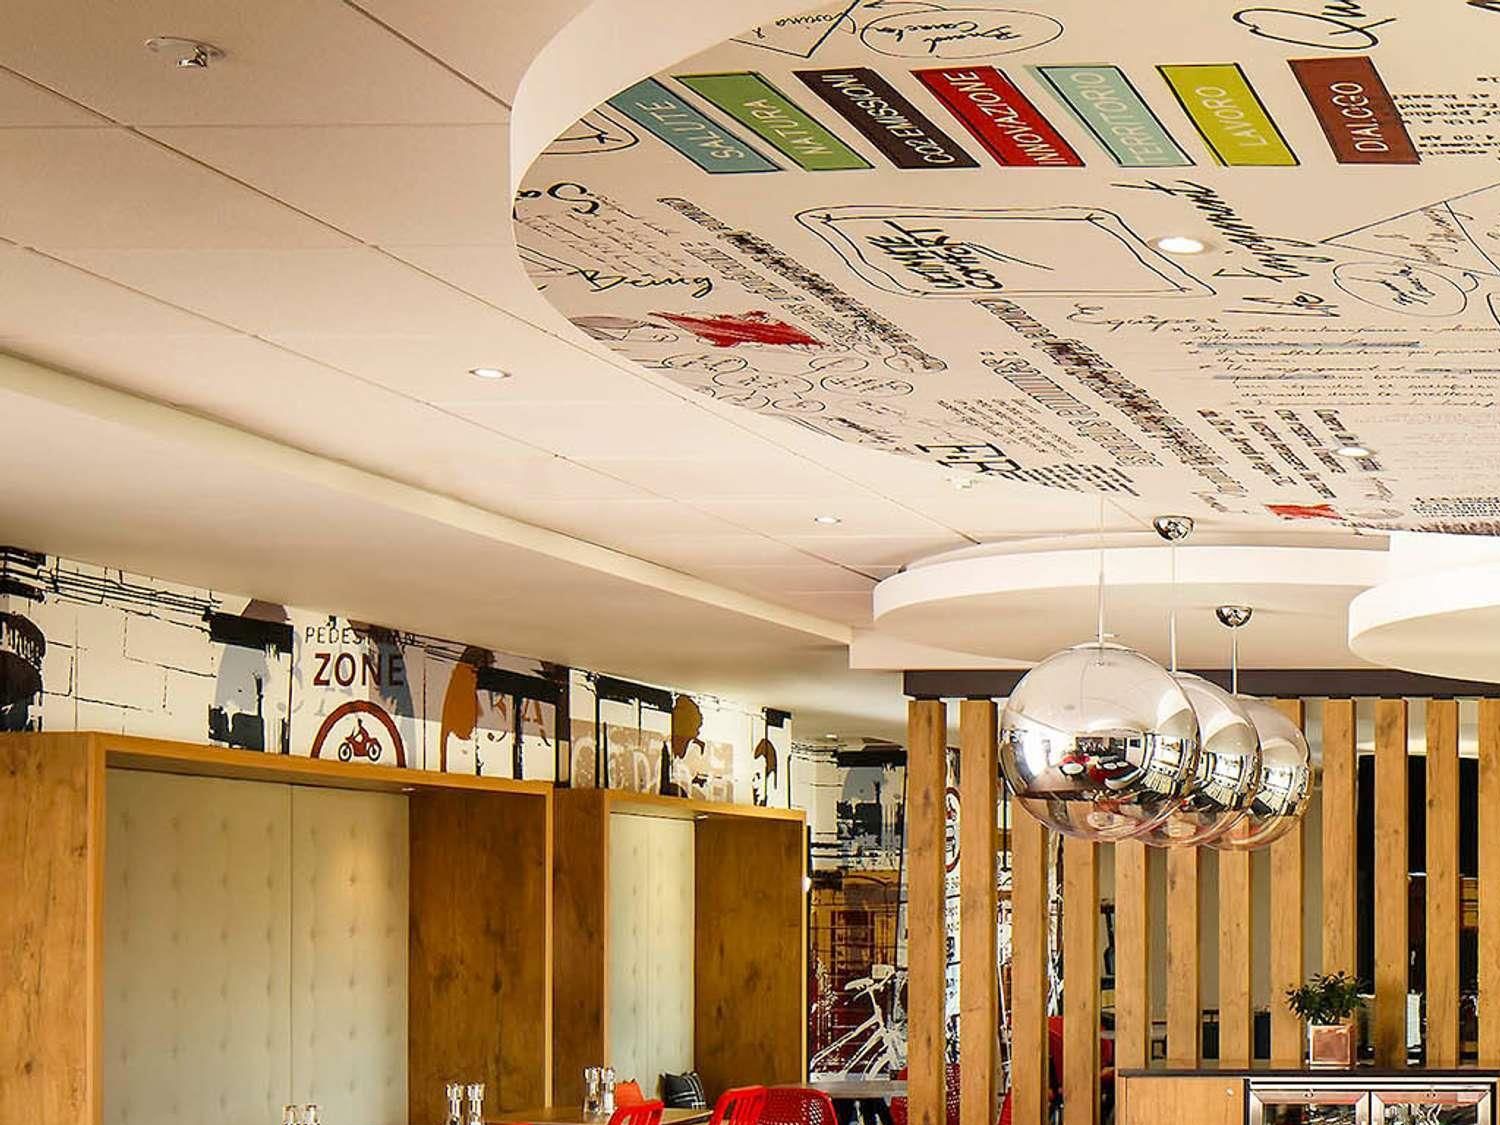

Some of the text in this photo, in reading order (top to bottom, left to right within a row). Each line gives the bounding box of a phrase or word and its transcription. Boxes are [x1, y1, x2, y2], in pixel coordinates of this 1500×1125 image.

[636, 100, 745, 160] SALUTE
[745, 99, 833, 156] NATURA
[943, 71, 1068, 165] INNOVAZIONE
[1070, 72, 1164, 165] TERRITORIO
[1195, 86, 1267, 147] LAVORO
[313, 652, 405, 687] ZONE
